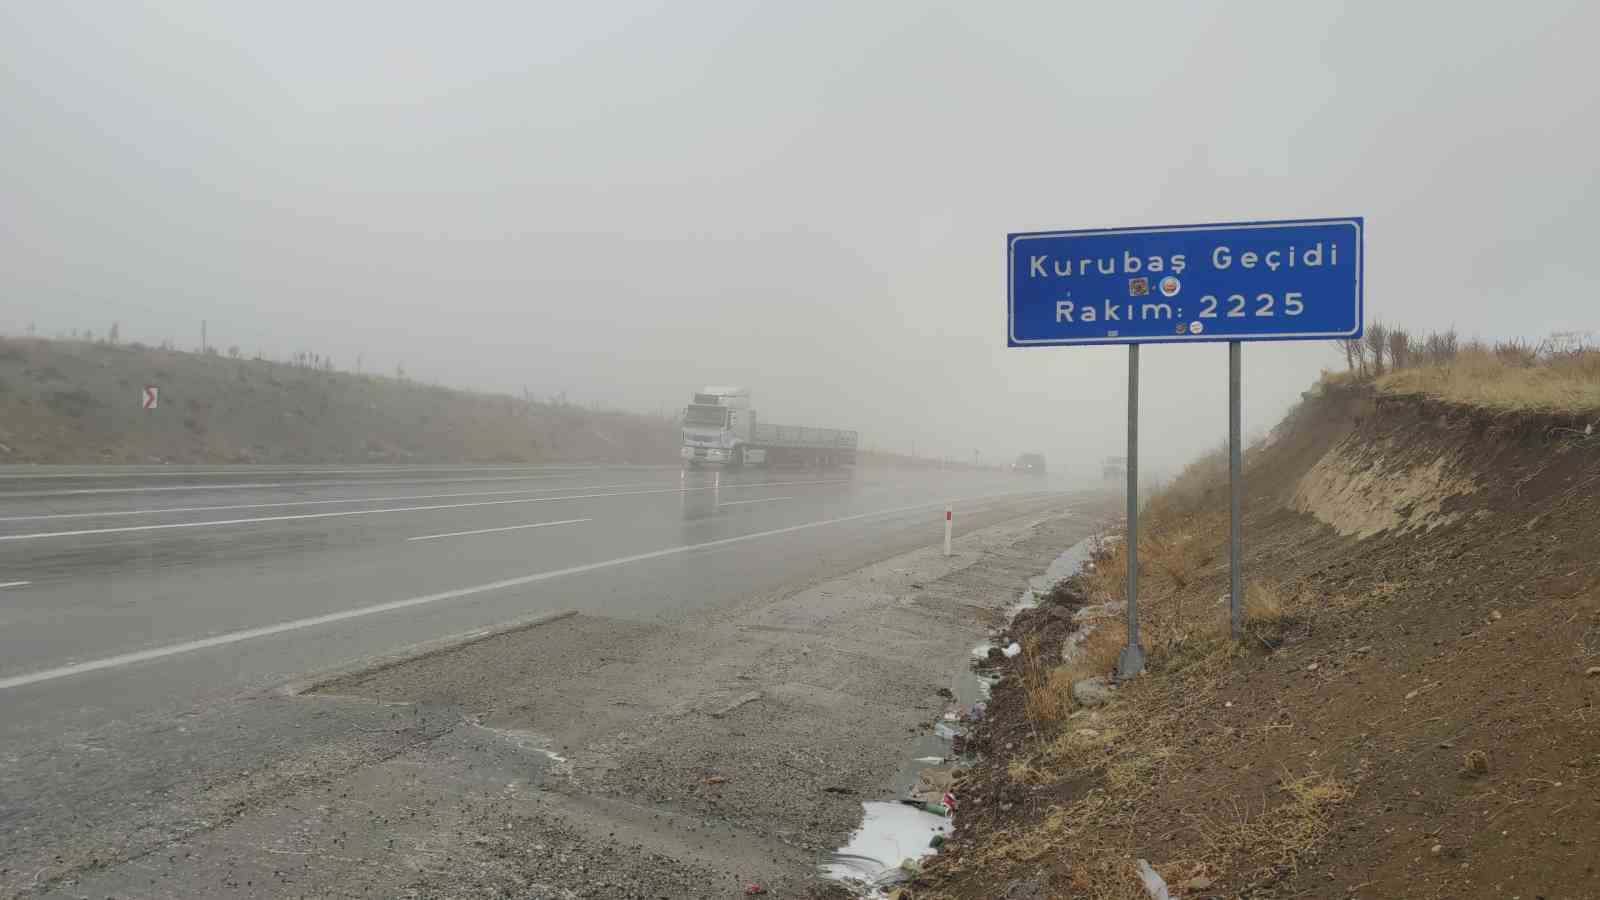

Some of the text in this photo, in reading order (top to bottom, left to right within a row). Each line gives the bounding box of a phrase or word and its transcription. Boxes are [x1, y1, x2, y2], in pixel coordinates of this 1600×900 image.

[1030, 242, 1338, 277] Kurubaş Geçidi
[1056, 292, 1305, 322] Rakım: 2225
